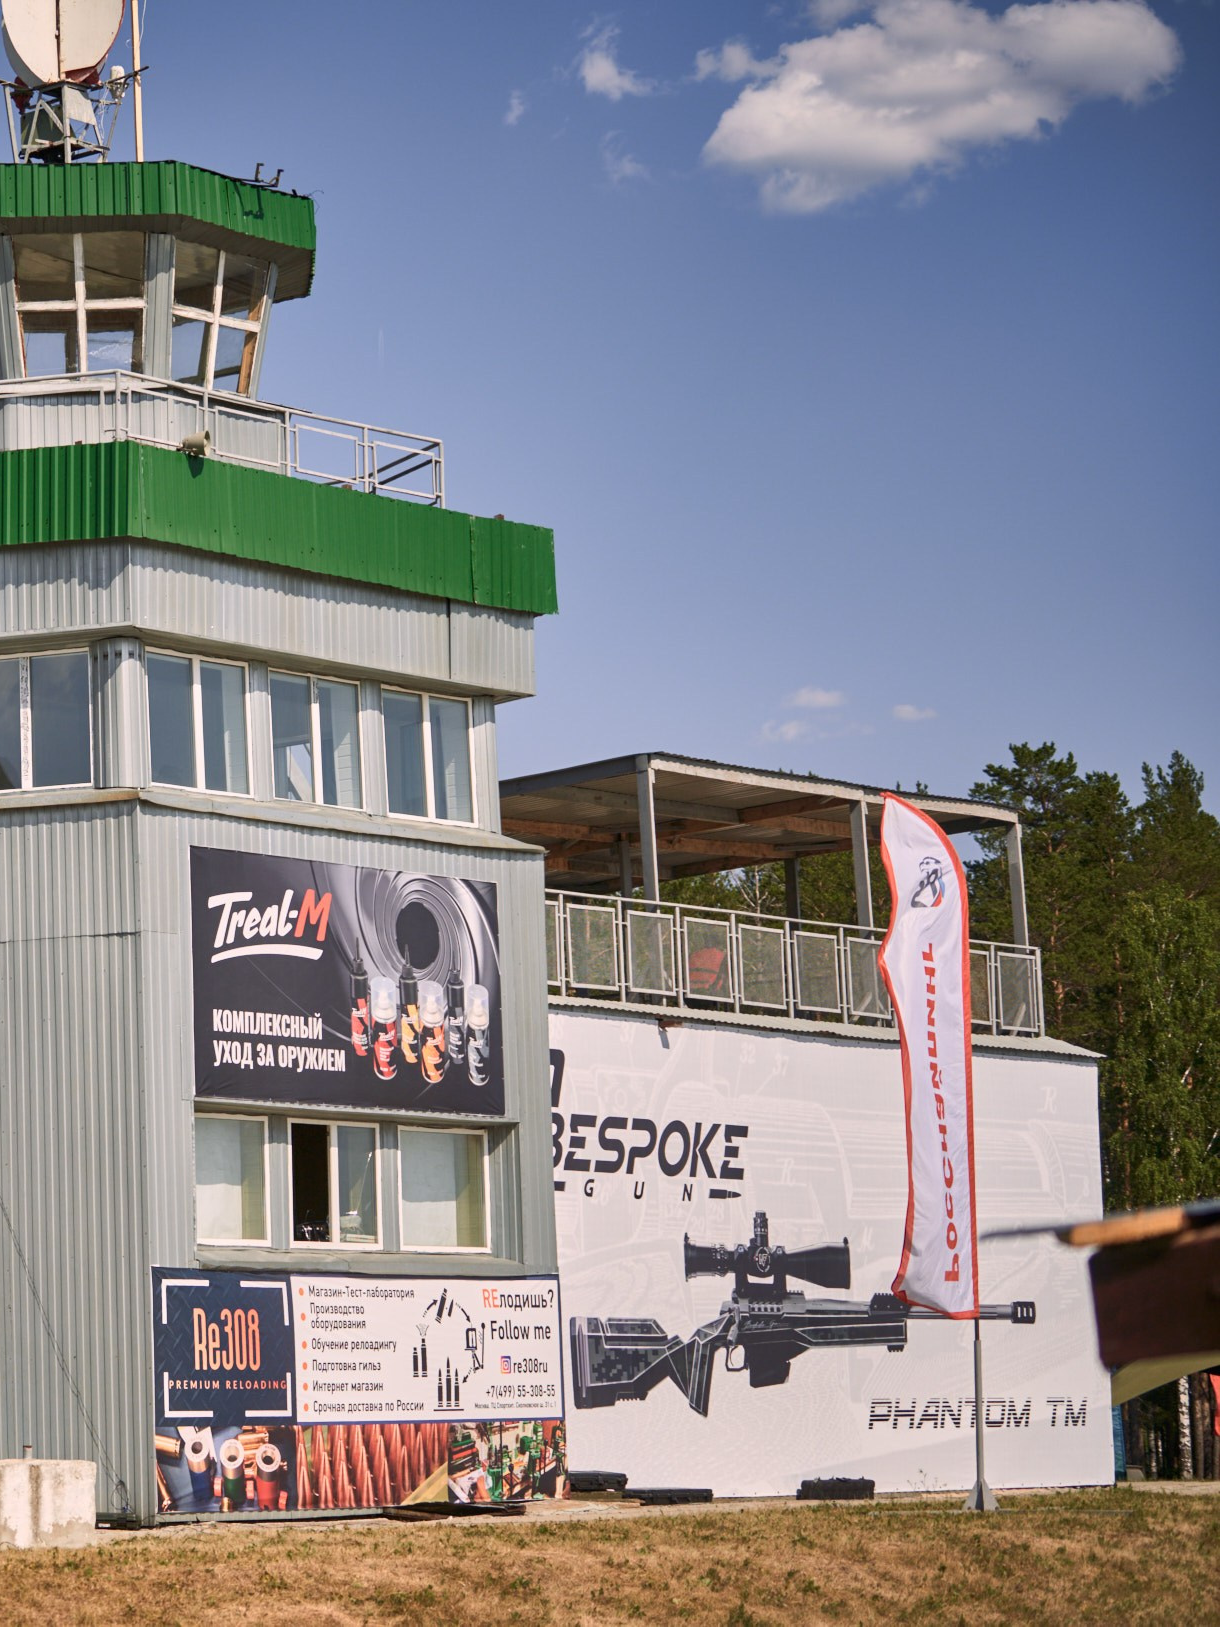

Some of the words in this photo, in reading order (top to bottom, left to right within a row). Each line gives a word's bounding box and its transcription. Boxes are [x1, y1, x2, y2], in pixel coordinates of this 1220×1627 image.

[208, 888, 332, 948] Treal-M
[212, 1008, 323, 1040] КОМПЛЕКСНЫЙ
[213, 1039, 254, 1070] УХОД
[256, 1042, 275, 1067] ЗА
[278, 1044, 346, 1073] ОРУЖИЕМ
[308, 1285, 415, 1300] Магазин-Тест-лаборатория
[310, 1302, 365, 1317] Производство
[311, 1316, 367, 1331] оборудования
[490, 1320, 530, 1340] Follow
[534, 1325, 551, 1340] me
[192, 1307, 261, 1371] Re308
[311, 1338, 349, 1352] Обучение
[350, 1341, 397, 1352] релоадингу
[312, 1359, 357, 1373] Подготовка
[358, 1362, 381, 1371] гильз
[513, 1358, 548, 1373] re308ru
[168, 1380, 220, 1390] PREMIUM
[225, 1380, 287, 1390] RELOADING
[312, 1380, 349, 1394] Интернет
[351, 1382, 384, 1391] магазин
[486, 1385, 515, 1399] +7(499)
[517, 1384, 556, 1397] 55-308-55
[313, 1400, 346, 1415] Срочная
[347, 1403, 383, 1414] доставка
[385, 1403, 395, 1411] по
[396, 1399, 425, 1411] России
[868, 1397, 1032, 1430] PHANTOM
[1046, 1397, 1088, 1427] TM
